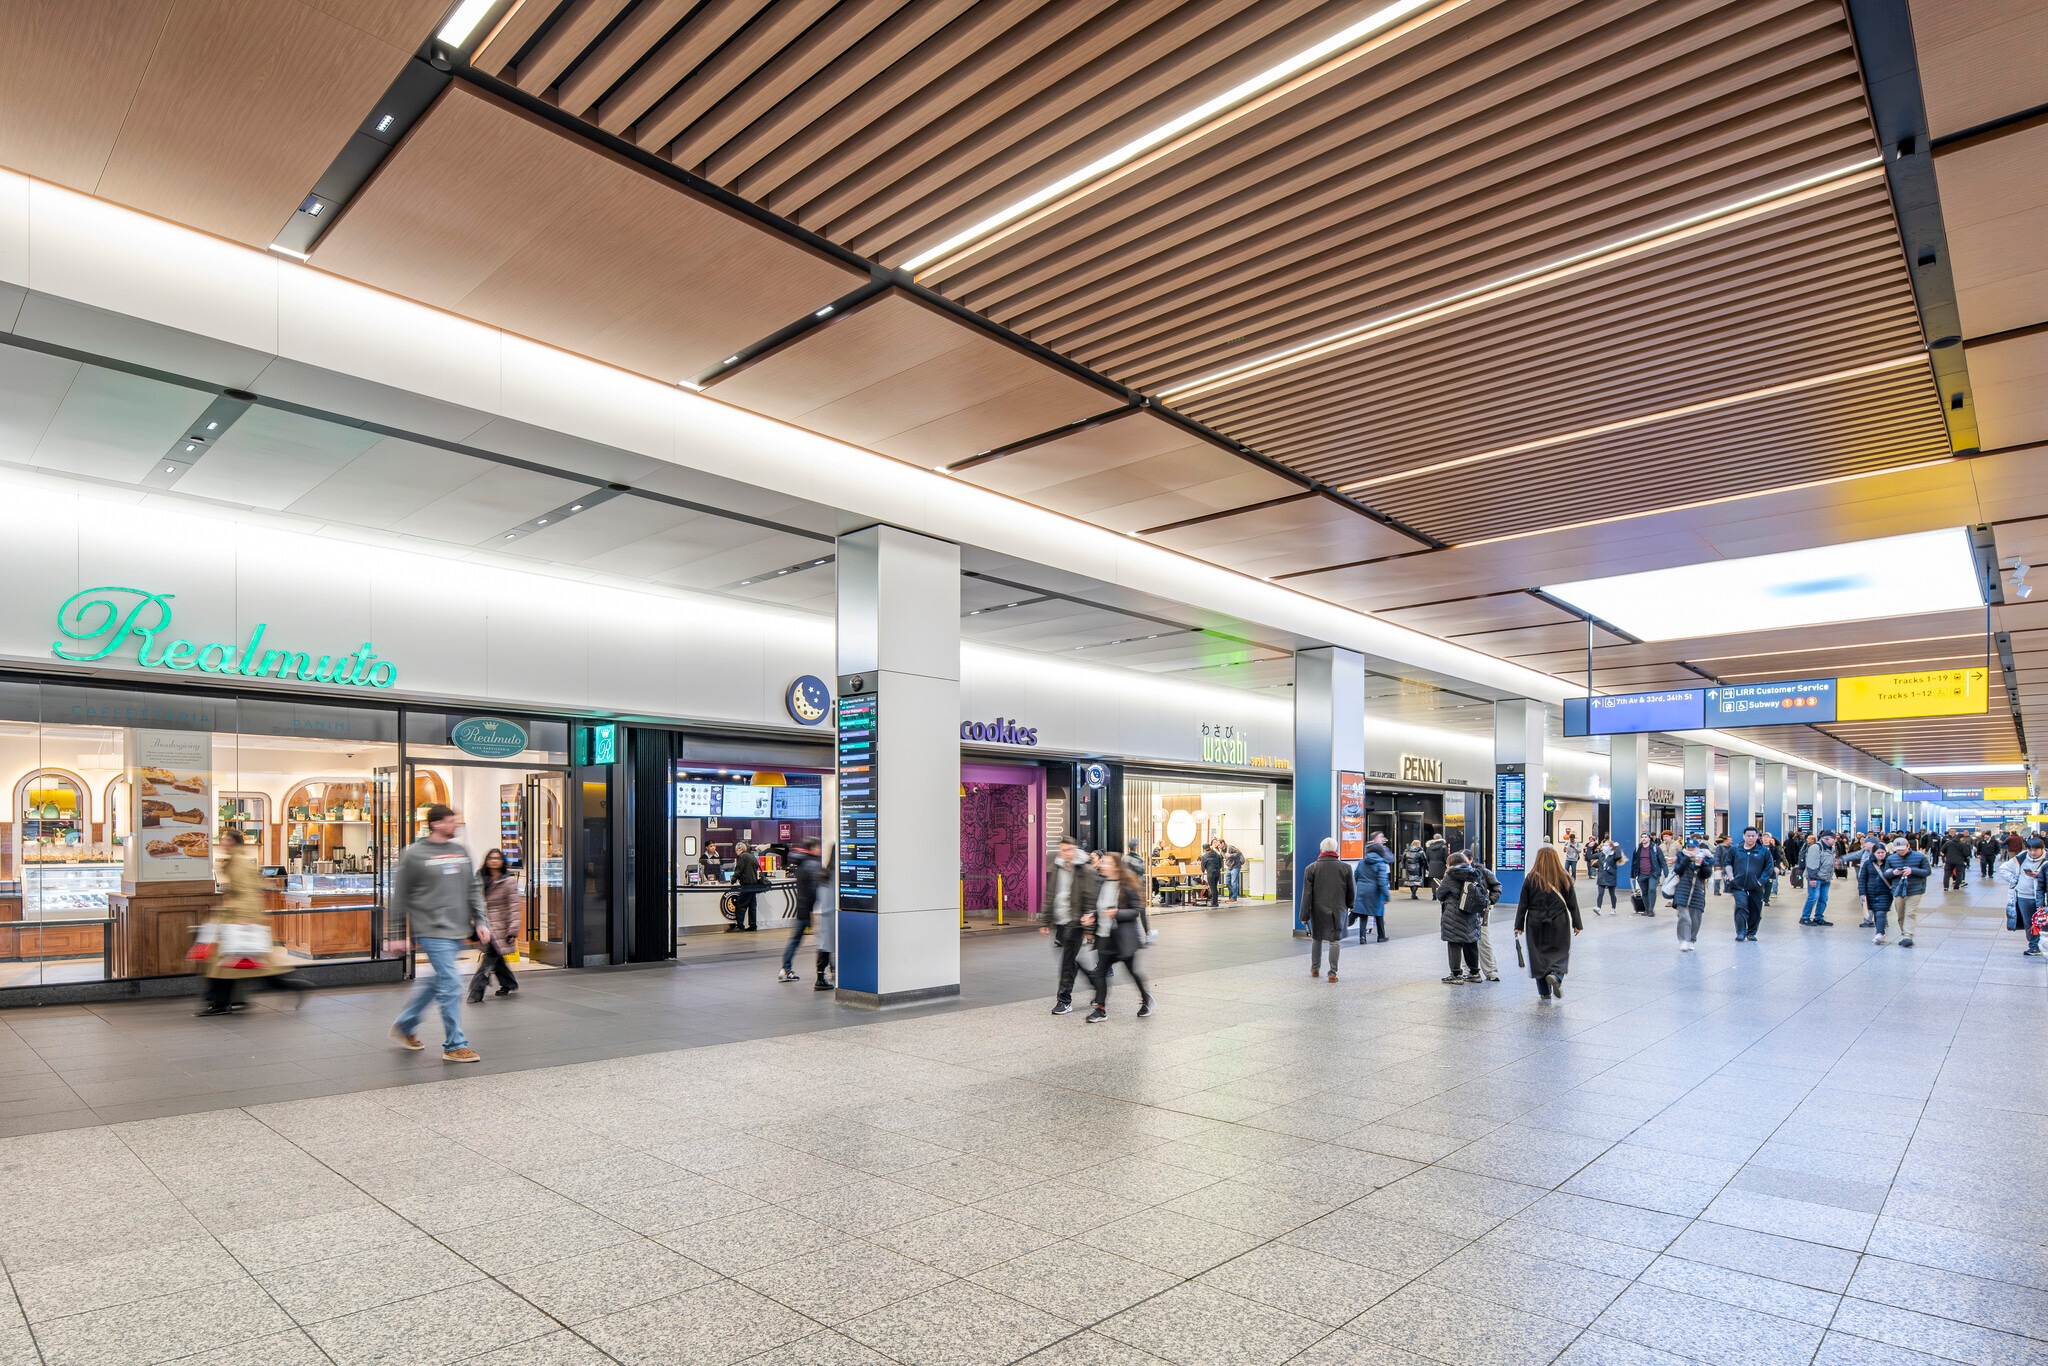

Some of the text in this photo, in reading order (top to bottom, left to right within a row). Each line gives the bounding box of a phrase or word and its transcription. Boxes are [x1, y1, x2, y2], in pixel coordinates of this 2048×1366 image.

[52, 586, 397, 688] Realmuto
[1894, 674, 1949, 685] Tracks 1-19
[1735, 683, 1829, 696] LIRR Customer Service
[1878, 690, 1932, 700] Tracks 1-12
[1646, 695, 1665, 703] 33rd,
[1666, 693, 1683, 701] 34th
[1748, 700, 1780, 709] Subway
[460, 725, 521, 745] Realmuto
[960, 717, 1037, 746] cookies
[1201, 722, 1233, 738] わさび
[1203, 732, 1247, 765] wasabi
[1404, 756, 1443, 783] PENN 1
[709, 816, 716, 824] A
